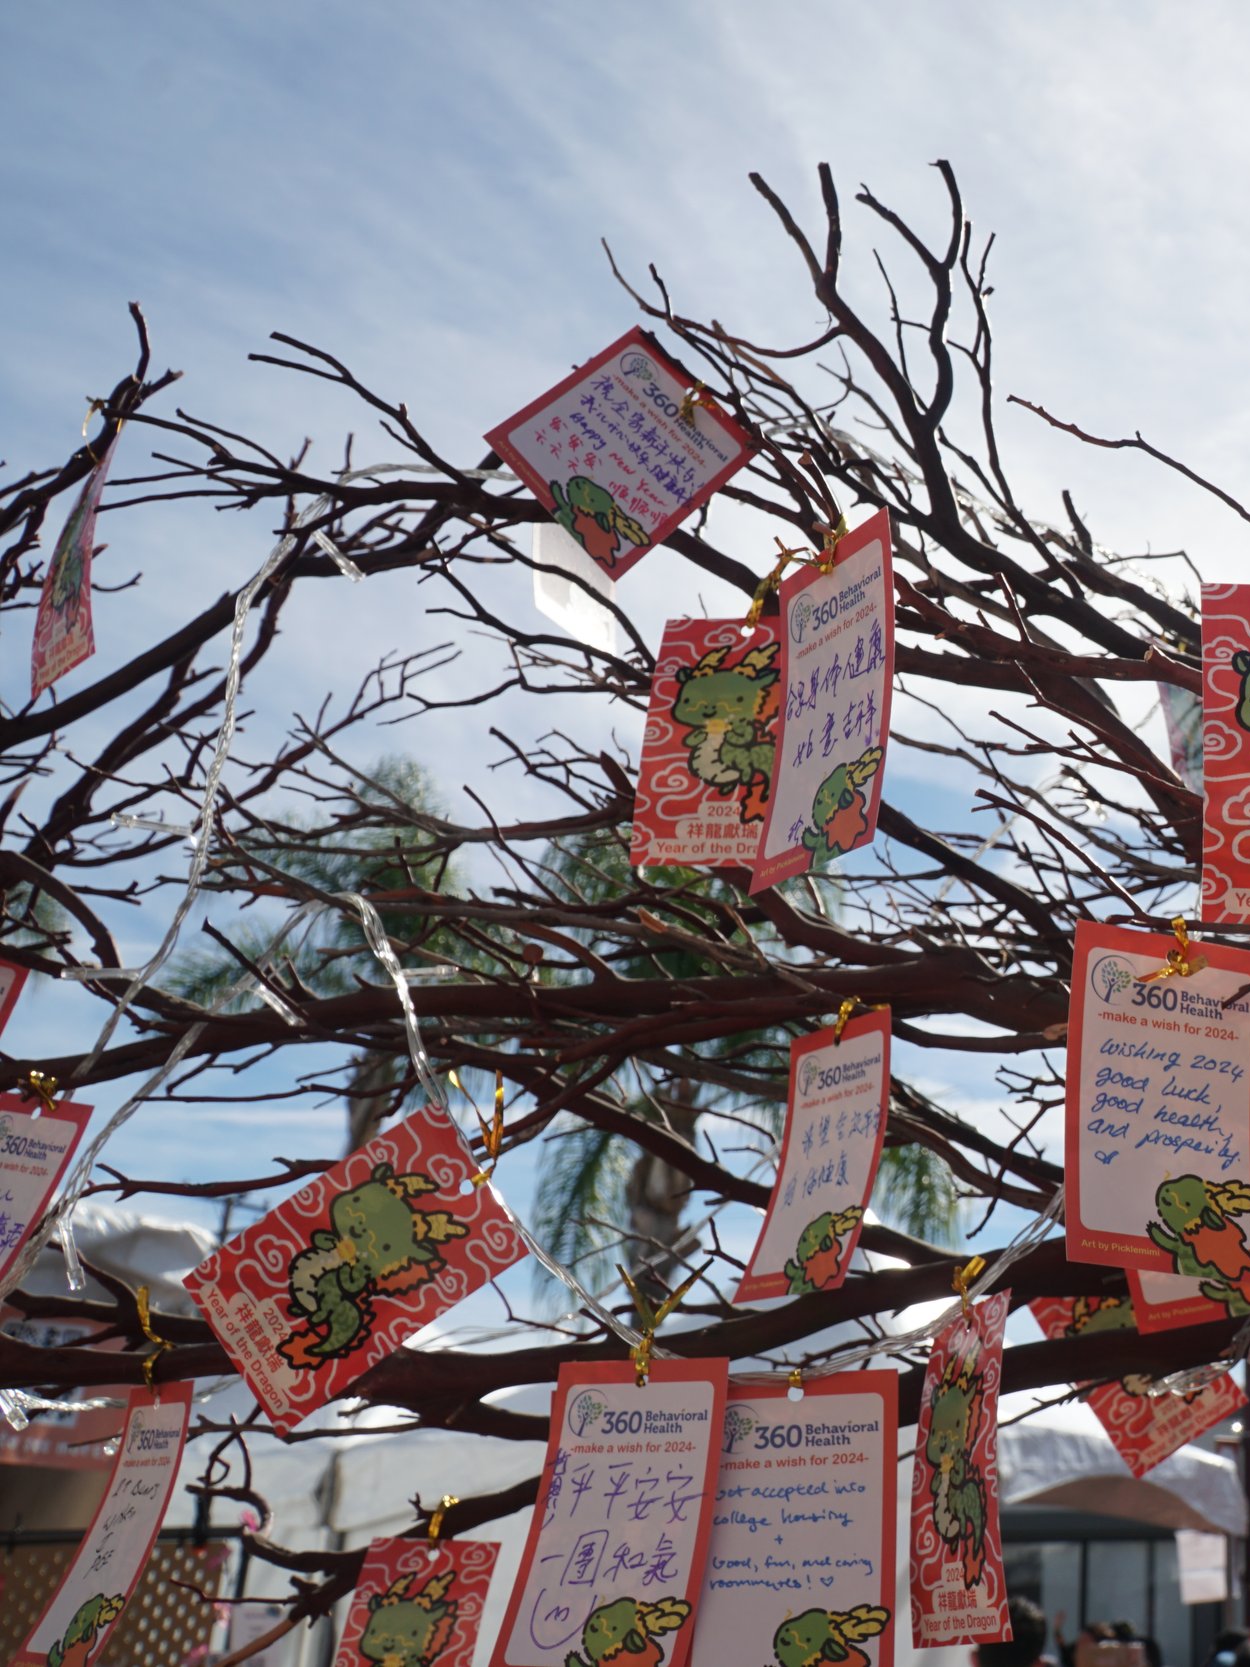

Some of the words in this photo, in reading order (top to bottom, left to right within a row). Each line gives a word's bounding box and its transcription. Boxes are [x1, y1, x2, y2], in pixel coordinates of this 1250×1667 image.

[569, 412, 607, 450] Happy
[812, 597, 838, 631] 360
[687, 823, 758, 839] 祥龍獻瑞
[1180, 1002, 1223, 1020] Health
[817, 1066, 841, 1090] 360
[842, 1054, 881, 1073] Behavioral
[1099, 1038, 1181, 1072] Wishing
[1190, 1055, 1244, 1084] 2024
[843, 1069, 866, 1083] Health
[1095, 1067, 1149, 1093] good
[1091, 1092, 1144, 1114] good
[1, 1135, 27, 1156] 360
[1081, 1238, 1096, 1250] Art
[1098, 1240, 1109, 1252] by
[1111, 1241, 1161, 1257] Picklemimi
[208, 1290, 231, 1320] Year
[225, 1322, 240, 1341] of
[234, 1336, 251, 1361] the
[248, 1355, 283, 1410] Dragon
[600, 1411, 643, 1434] 360
[645, 1410, 708, 1421] Behavioral
[643, 1423, 683, 1434] Health
[137, 1429, 155, 1450] 360
[753, 1424, 802, 1449] 360
[805, 1421, 879, 1435] Behavioral
[805, 1435, 851, 1447] Health
[751, 1481, 829, 1502] accepted
[834, 1479, 866, 1494] into
[713, 1511, 772, 1533] college
[802, 1556, 832, 1567] and
[923, 1615, 942, 1633] Year
[943, 1615, 951, 1631] of
[951, 1613, 965, 1630] the
[967, 1610, 997, 1630] Dragon
